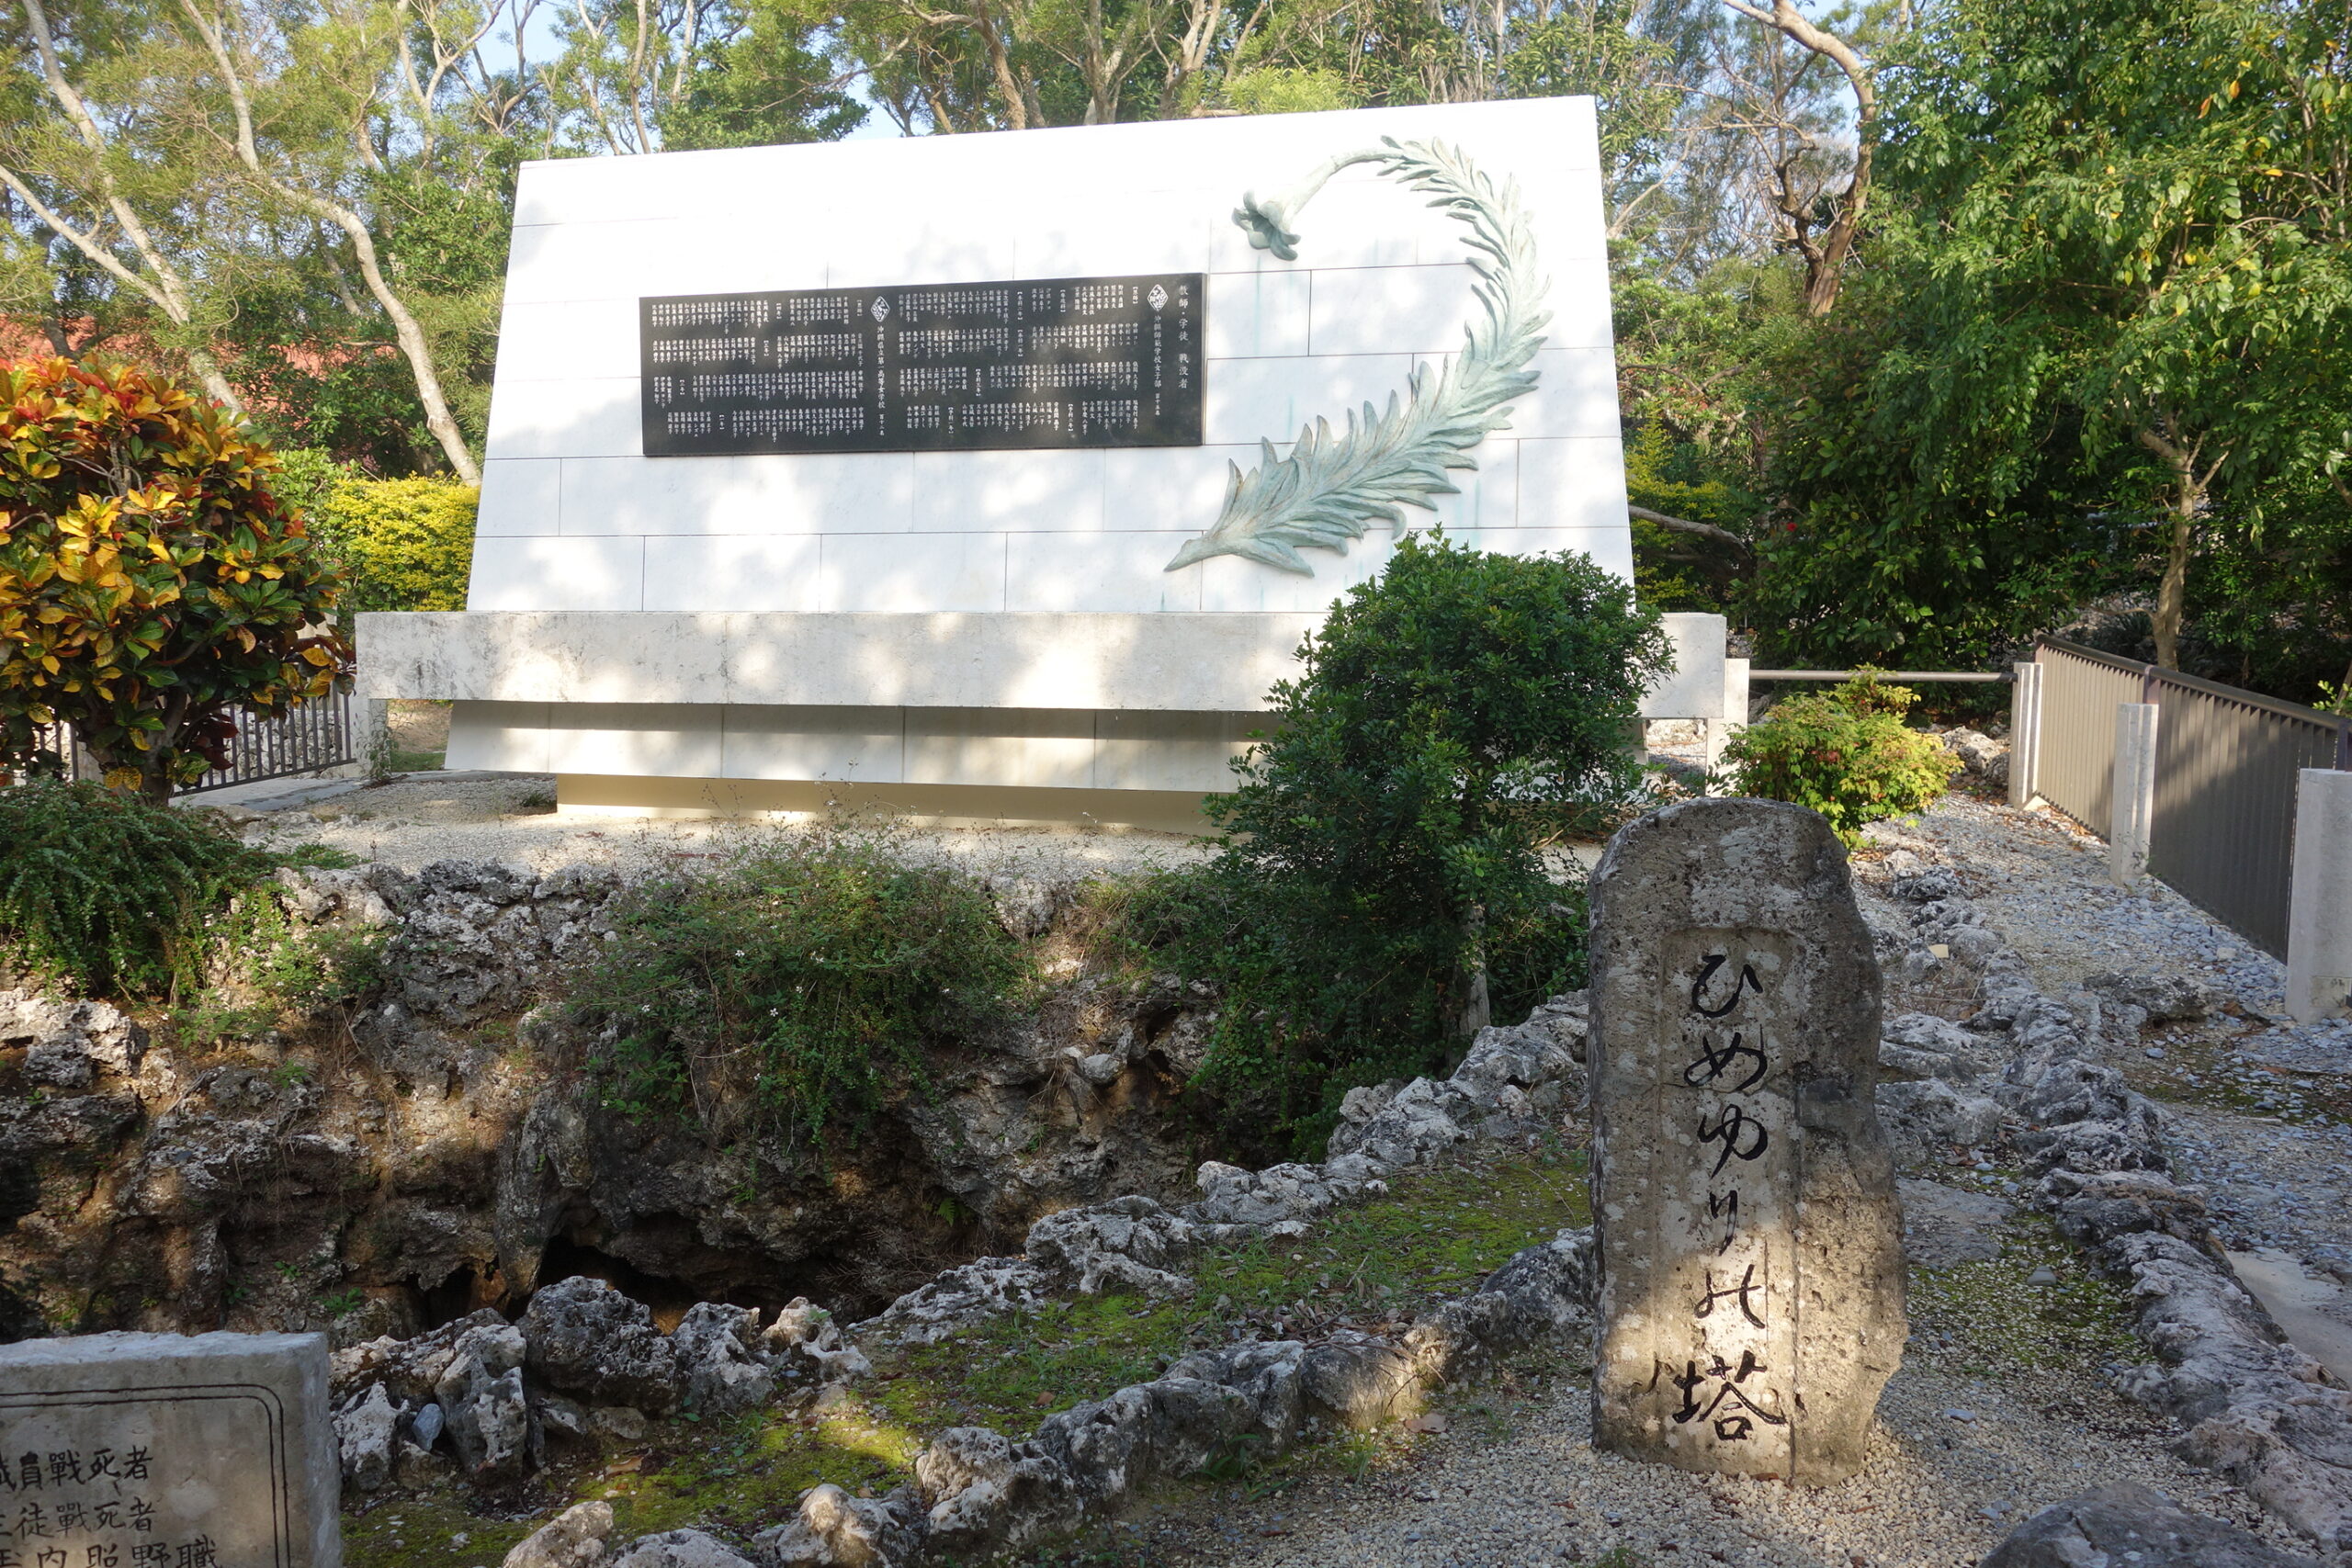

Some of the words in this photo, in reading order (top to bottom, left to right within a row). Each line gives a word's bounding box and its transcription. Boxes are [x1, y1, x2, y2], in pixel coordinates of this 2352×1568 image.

[1178, 353, 1189, 389] 戦没者
[1671, 953, 1786, 1441] ひめゆりの塔
